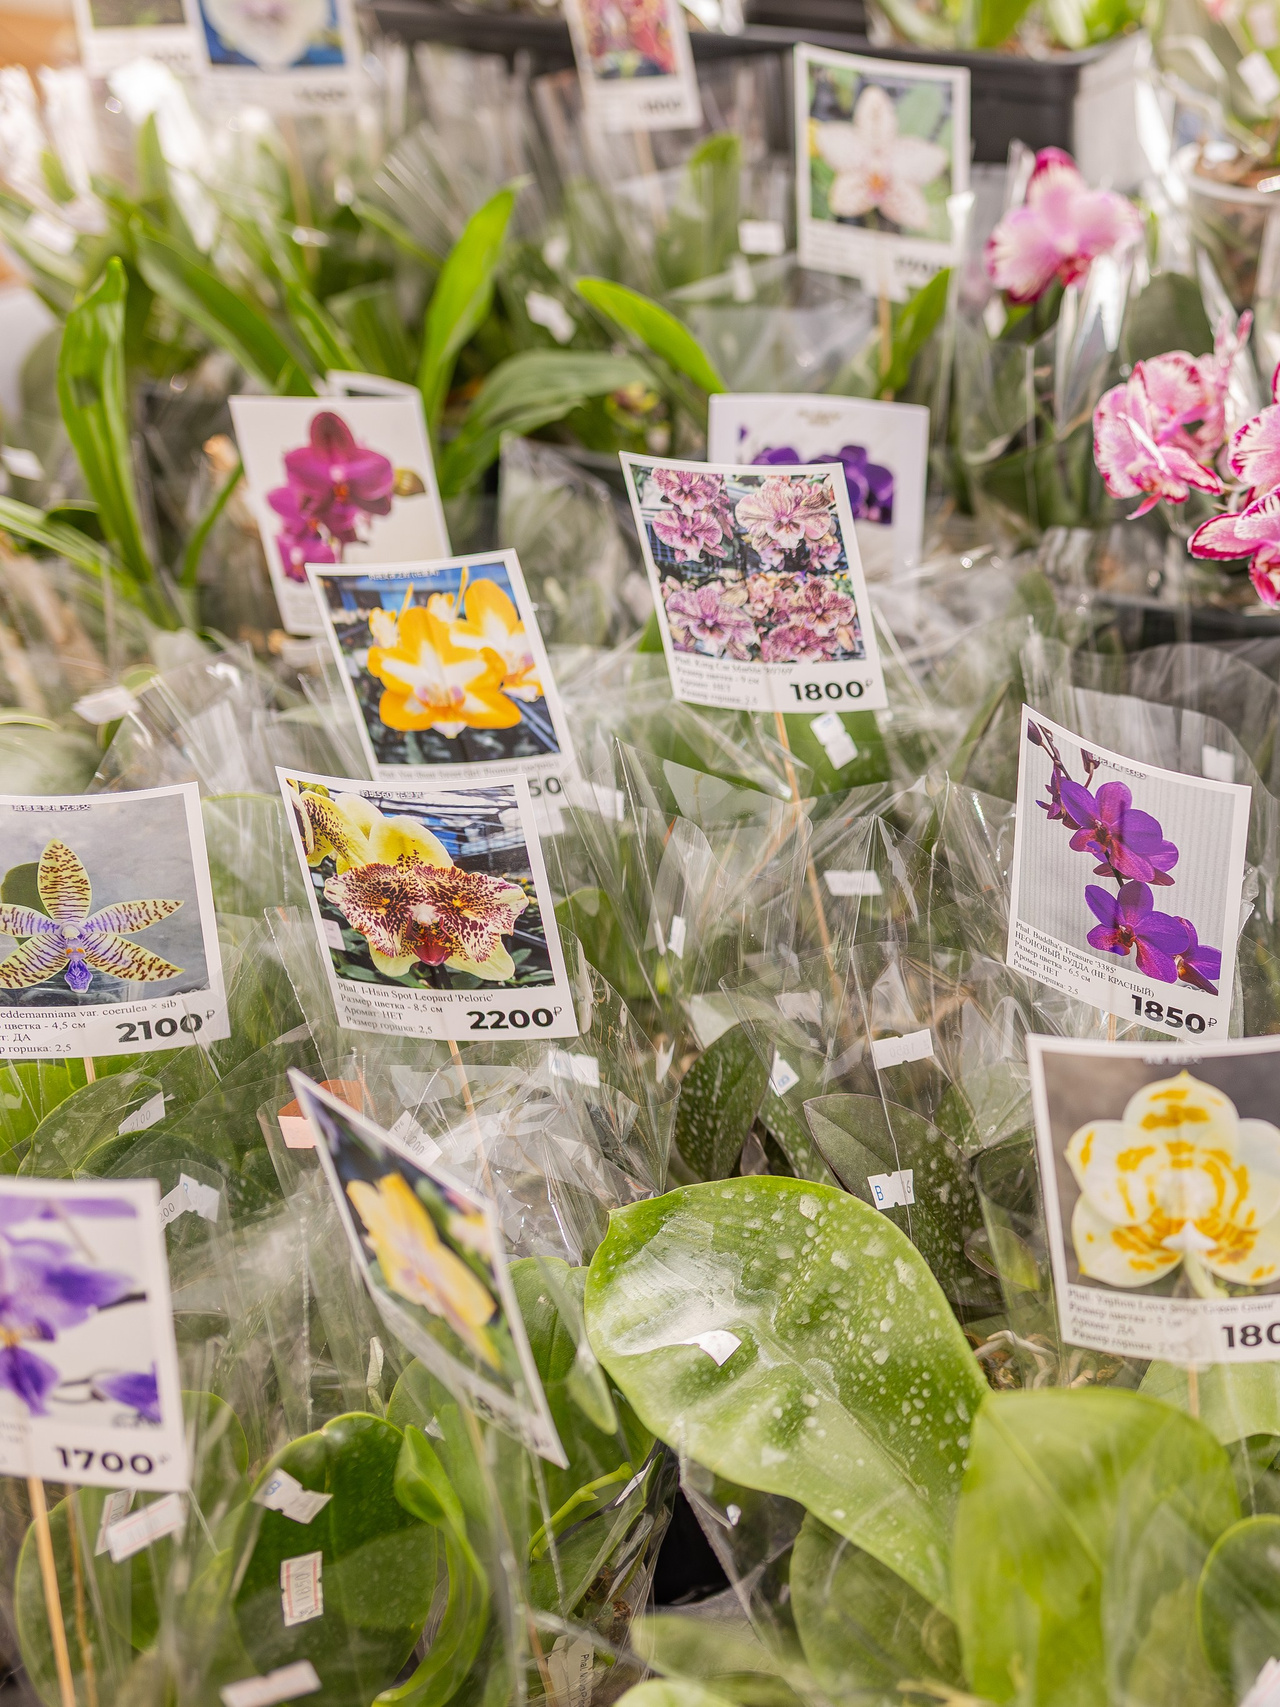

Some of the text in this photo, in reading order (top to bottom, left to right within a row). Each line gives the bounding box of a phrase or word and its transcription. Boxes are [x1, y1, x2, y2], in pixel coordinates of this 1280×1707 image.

[1015, 931, 1061, 959] НЕОНОВЫЙ
[1062, 953, 1089, 973] БУДДА
[1016, 921, 1031, 934] Phal.
[1033, 931, 1063, 951] Buddha's
[1064, 945, 1093, 965] Treasure
[1014, 941, 1038, 958] Размер
[1039, 952, 1063, 968] цветка
[1043, 964, 1059, 976] НЕТ
[338, 983, 359, 993] Phal.
[392, 990, 412, 1001] Spot
[415, 992, 453, 1003] Leopard
[0, 1009, 76, 1019] eddemanniana
[102, 1005, 147, 1016] coerulea
[161, 1000, 177, 1009] sib
[340, 994, 373, 1008] Размер
[374, 1002, 405, 1010] цветка
[414, 1004, 429, 1013] 8,5
[344, 1006, 404, 1020] Аромат: НЕТ
[4, 1022, 41, 1031] цветка
[52, 1021, 68, 1032] 4,5
[345, 1016, 433, 1034] Размер горшка: 2,5
[13, 1034, 31, 1043] ДА
[8, 1045, 52, 1054] горшка:
[55, 1044, 71, 1052] 2,5
